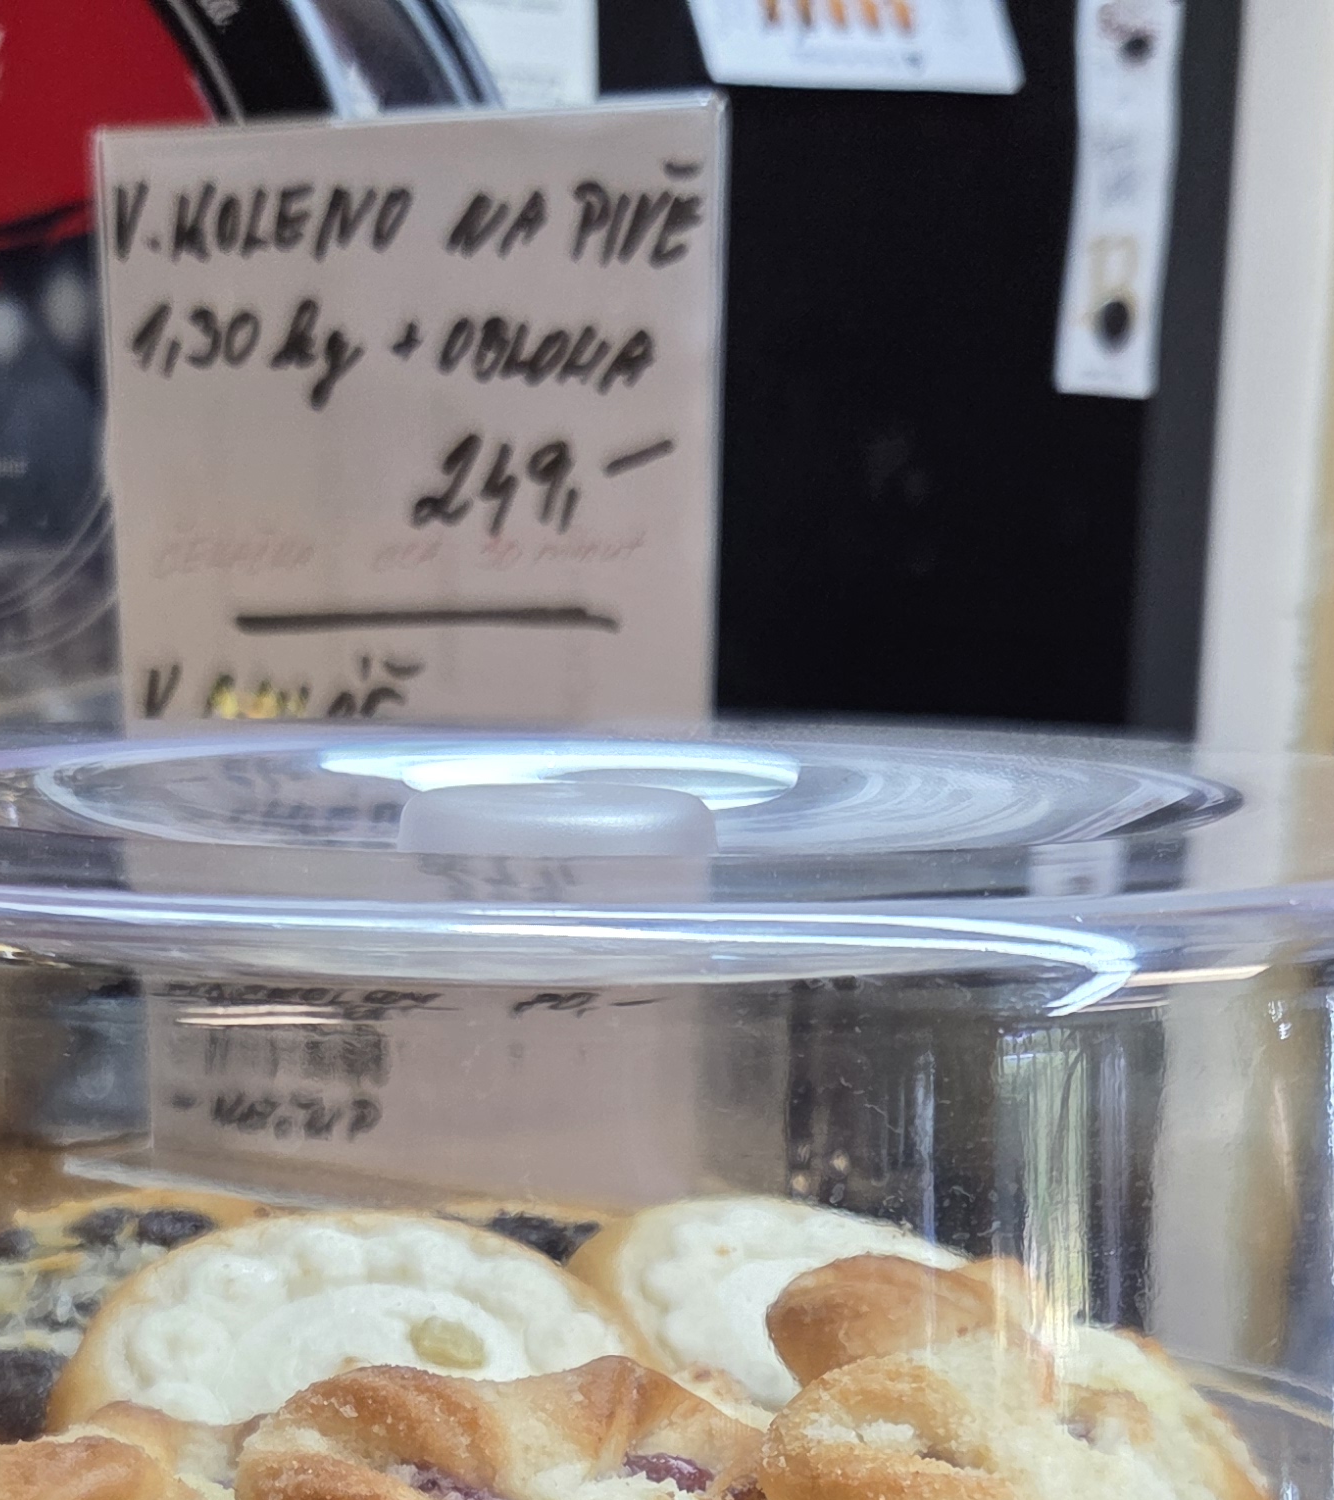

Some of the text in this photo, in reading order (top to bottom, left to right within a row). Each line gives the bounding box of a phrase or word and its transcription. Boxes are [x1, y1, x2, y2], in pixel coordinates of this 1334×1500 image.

[445, 189, 547, 257] NA
[129, 301, 261, 377] 1,30
[269, 296, 364, 410] kg
